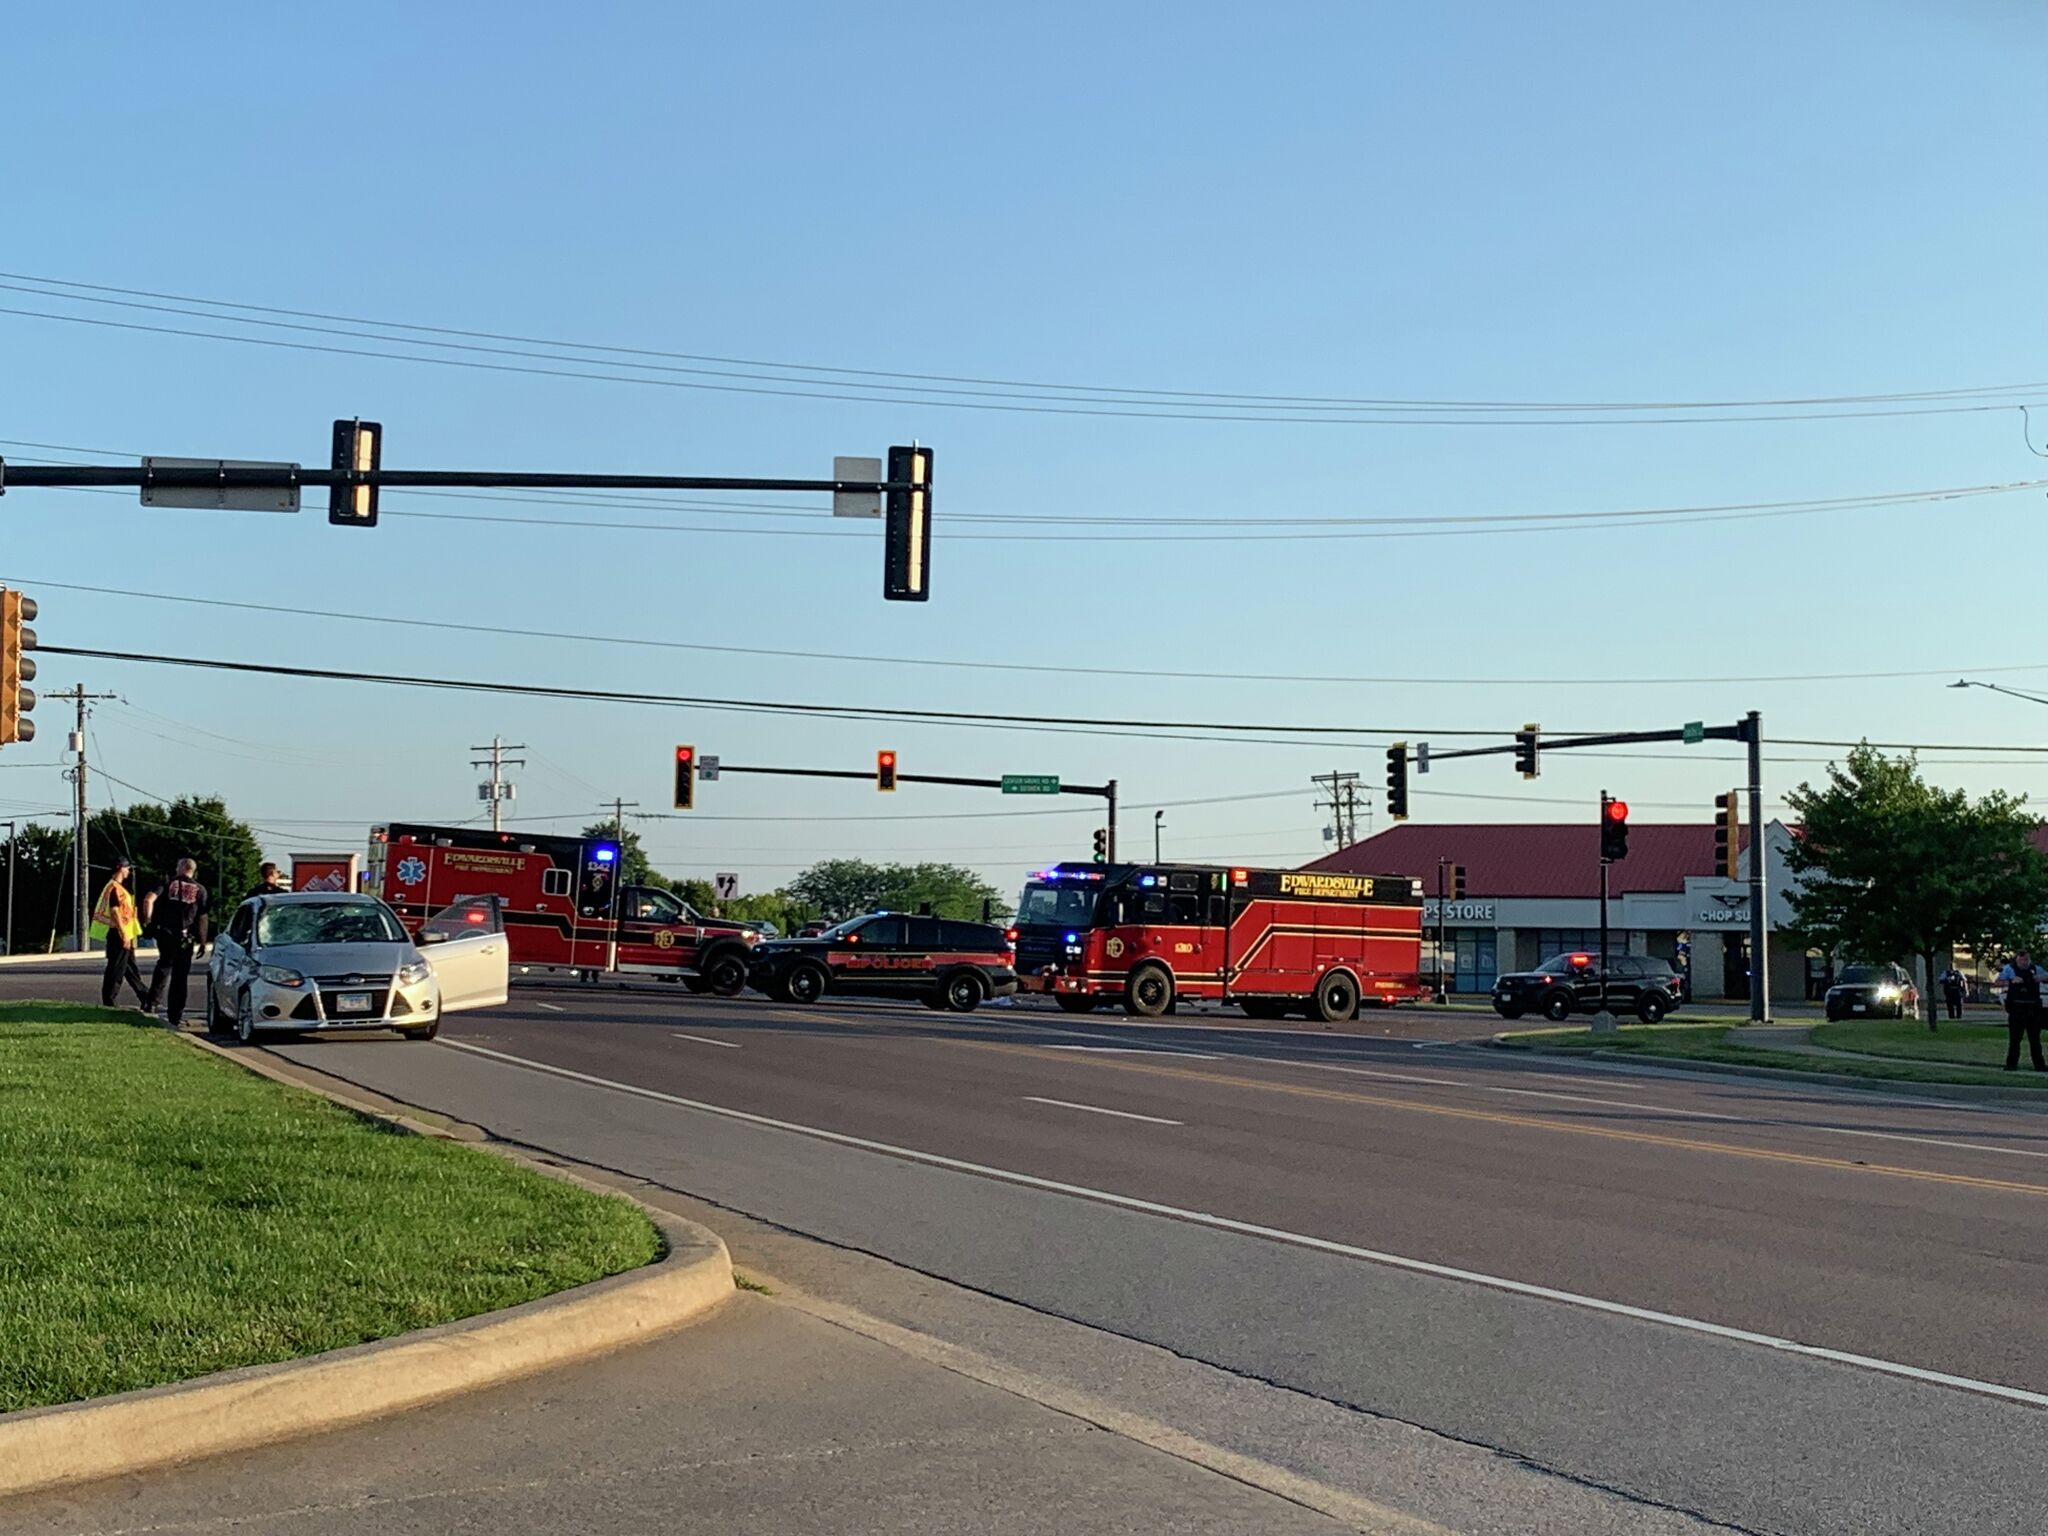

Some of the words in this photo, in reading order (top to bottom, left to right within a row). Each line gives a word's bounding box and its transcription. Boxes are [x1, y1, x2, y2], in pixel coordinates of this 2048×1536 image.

[1280, 874, 1374, 897] EDWARDSVILLE
[1294, 887, 1311, 896] FIRE
[1312, 888, 1359, 898] DEPARTMENT
[1446, 904, 1493, 919] STORE
[1699, 910, 1733, 921] CHOP
